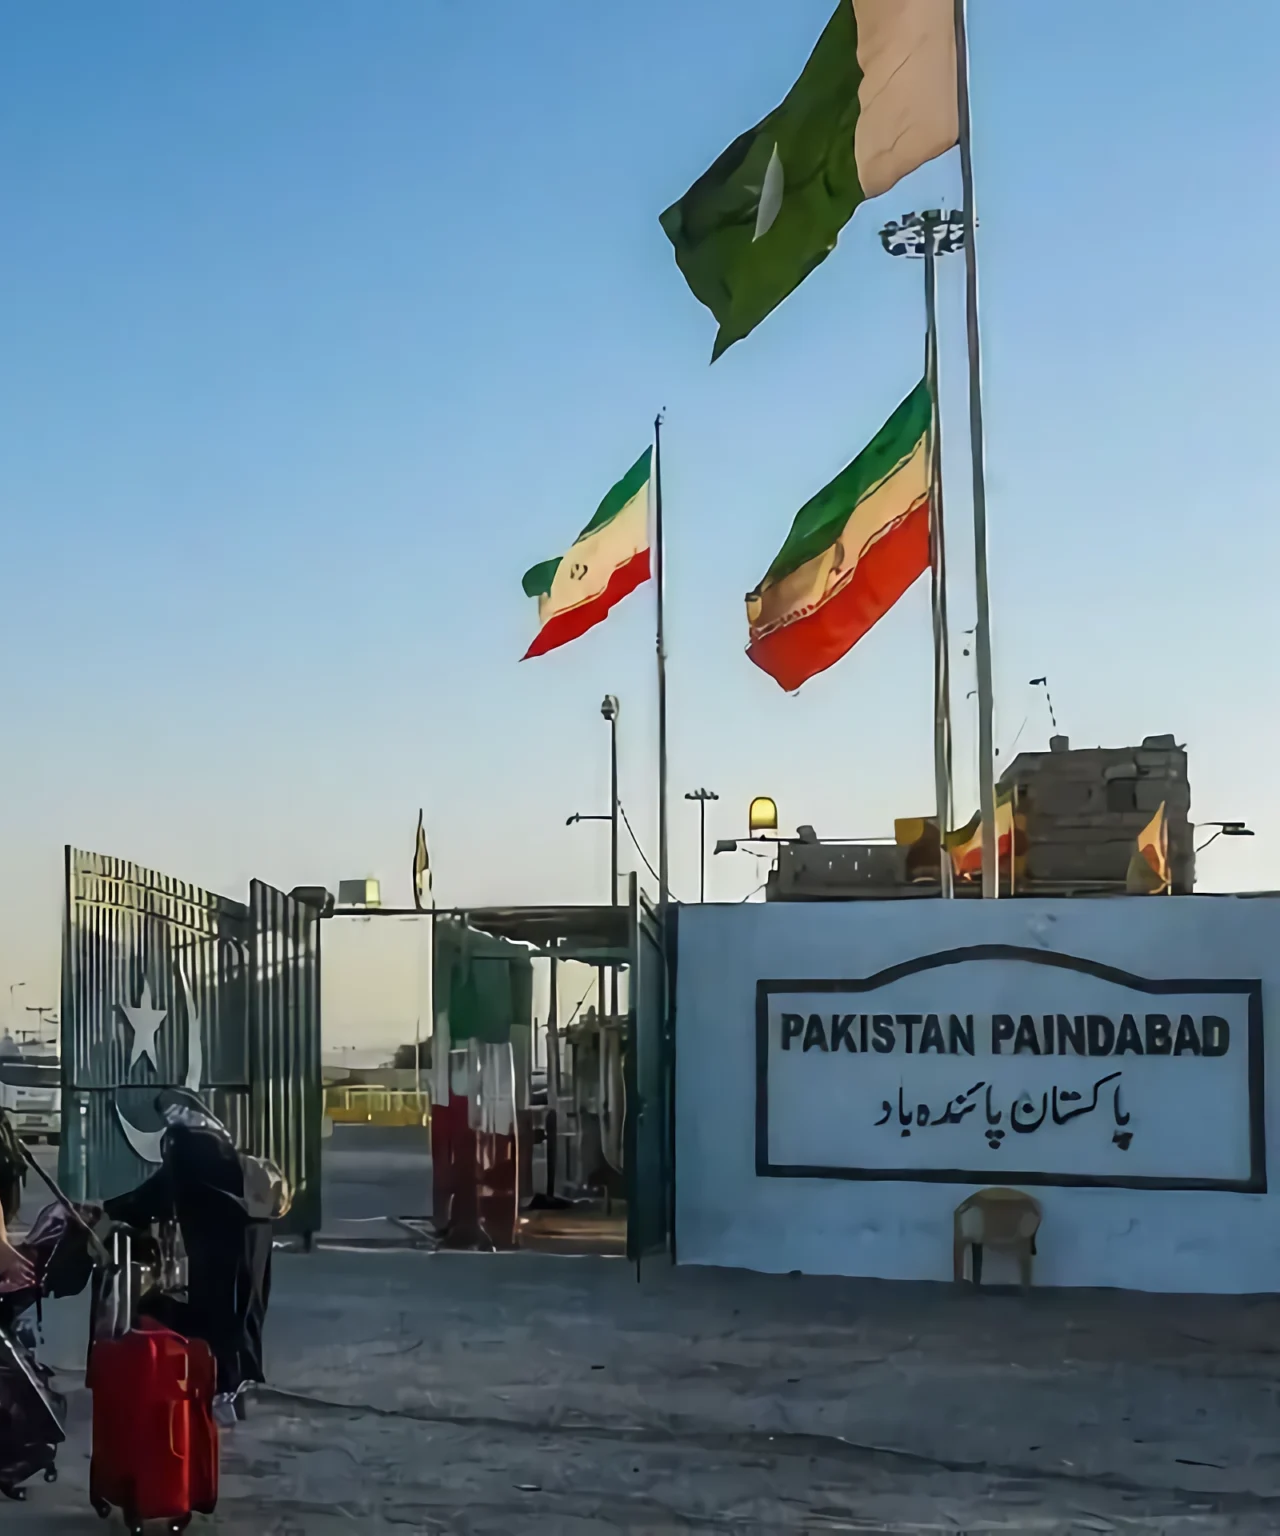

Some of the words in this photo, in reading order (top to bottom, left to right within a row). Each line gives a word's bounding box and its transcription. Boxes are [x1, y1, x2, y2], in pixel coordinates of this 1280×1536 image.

[780, 1013, 976, 1057] PAKISTAN
[991, 1013, 1231, 1058] PAINDABAD
[1010, 1071, 1134, 1151] پاکستان
